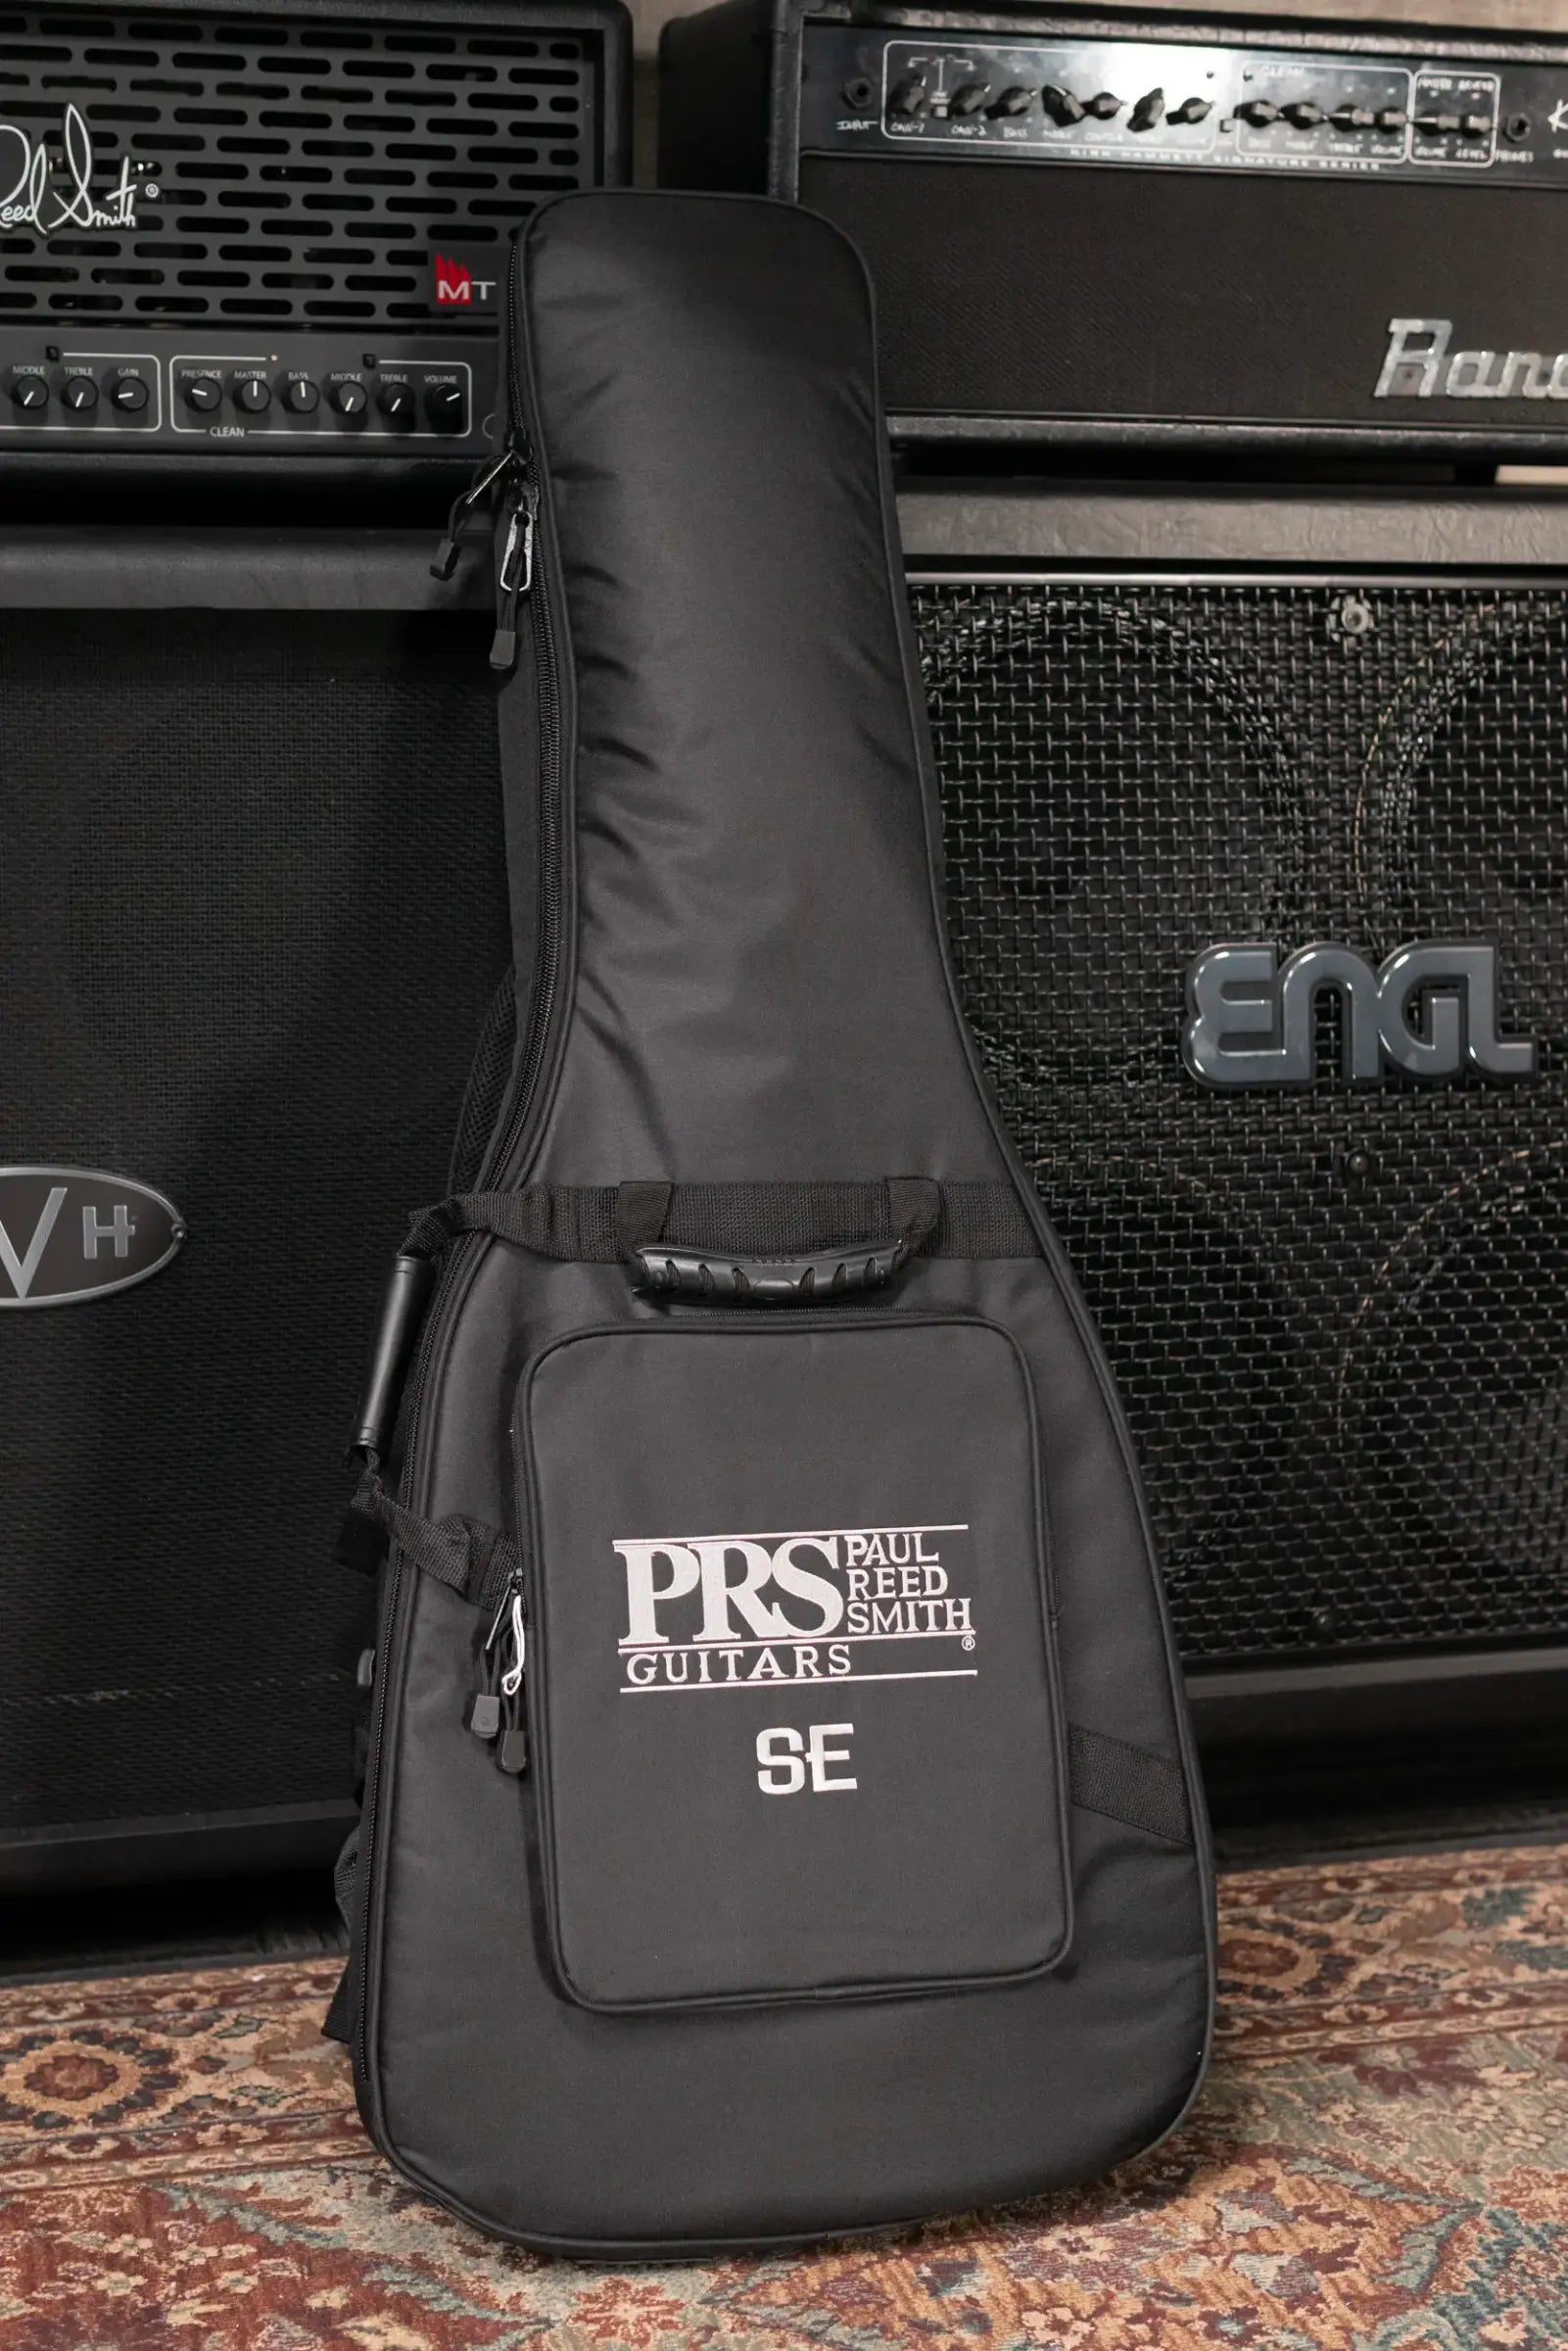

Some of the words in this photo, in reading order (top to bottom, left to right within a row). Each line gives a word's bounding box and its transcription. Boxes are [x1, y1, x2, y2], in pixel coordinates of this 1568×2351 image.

[438, 280, 497, 300] MT
[13, 365, 45, 376] MIDDLE
[65, 366, 94, 376] TREBLE
[118, 368, 139, 377] GAIN
[181, 369, 222, 379] PRESENCE
[234, 370, 266, 380] MASTER
[288, 372, 309, 381] BASS
[330, 373, 362, 382] MIDDLE
[380, 374, 407, 383] TREBLE
[424, 374, 457, 384] VOLUME
[210, 427, 245, 439] CLEAN
[1182, 941, 1538, 1088] ENGL
[843, 1532, 940, 1567] PAUL
[846, 1565, 949, 1602] REED
[614, 1536, 844, 1646] PRS
[846, 1598, 974, 1635] SMITH
[626, 1644, 852, 1686] GUITARS
[756, 1723, 858, 1796] SE
